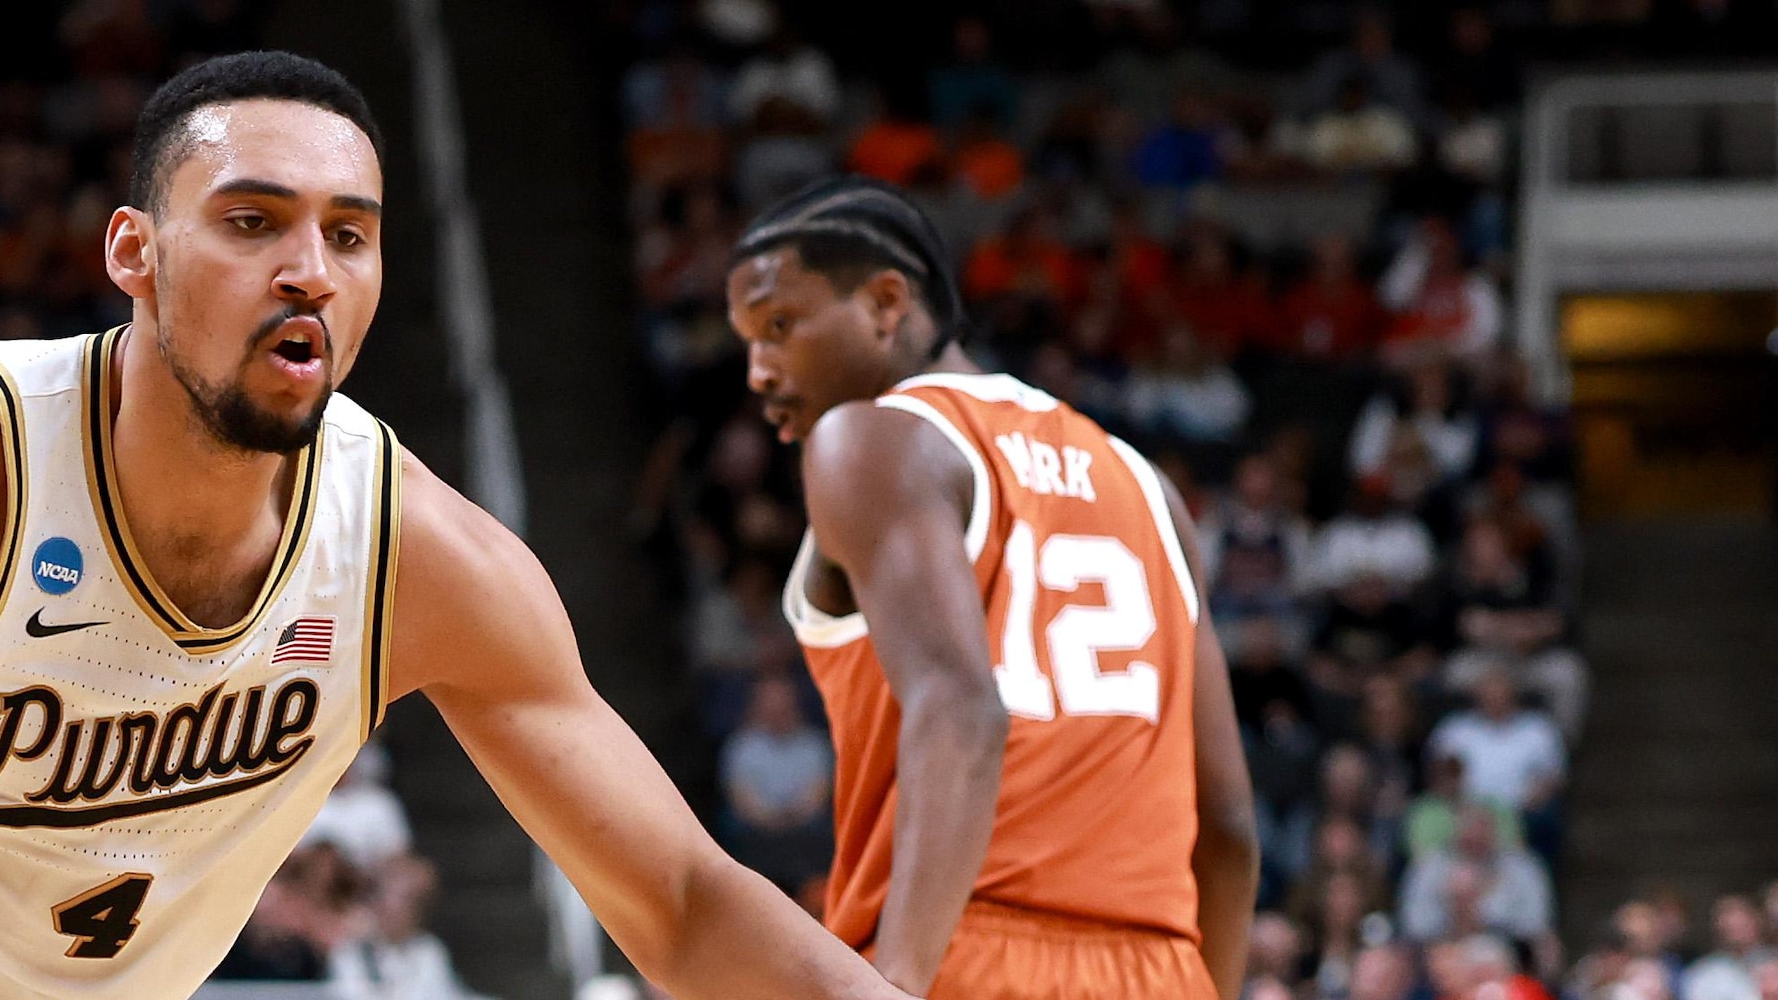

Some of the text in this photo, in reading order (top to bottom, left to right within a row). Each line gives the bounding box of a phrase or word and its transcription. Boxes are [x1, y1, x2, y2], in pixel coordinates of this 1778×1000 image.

[37, 561, 79, 584] NCAA
[992, 518, 1160, 726] 12
[51, 871, 154, 958] 4
